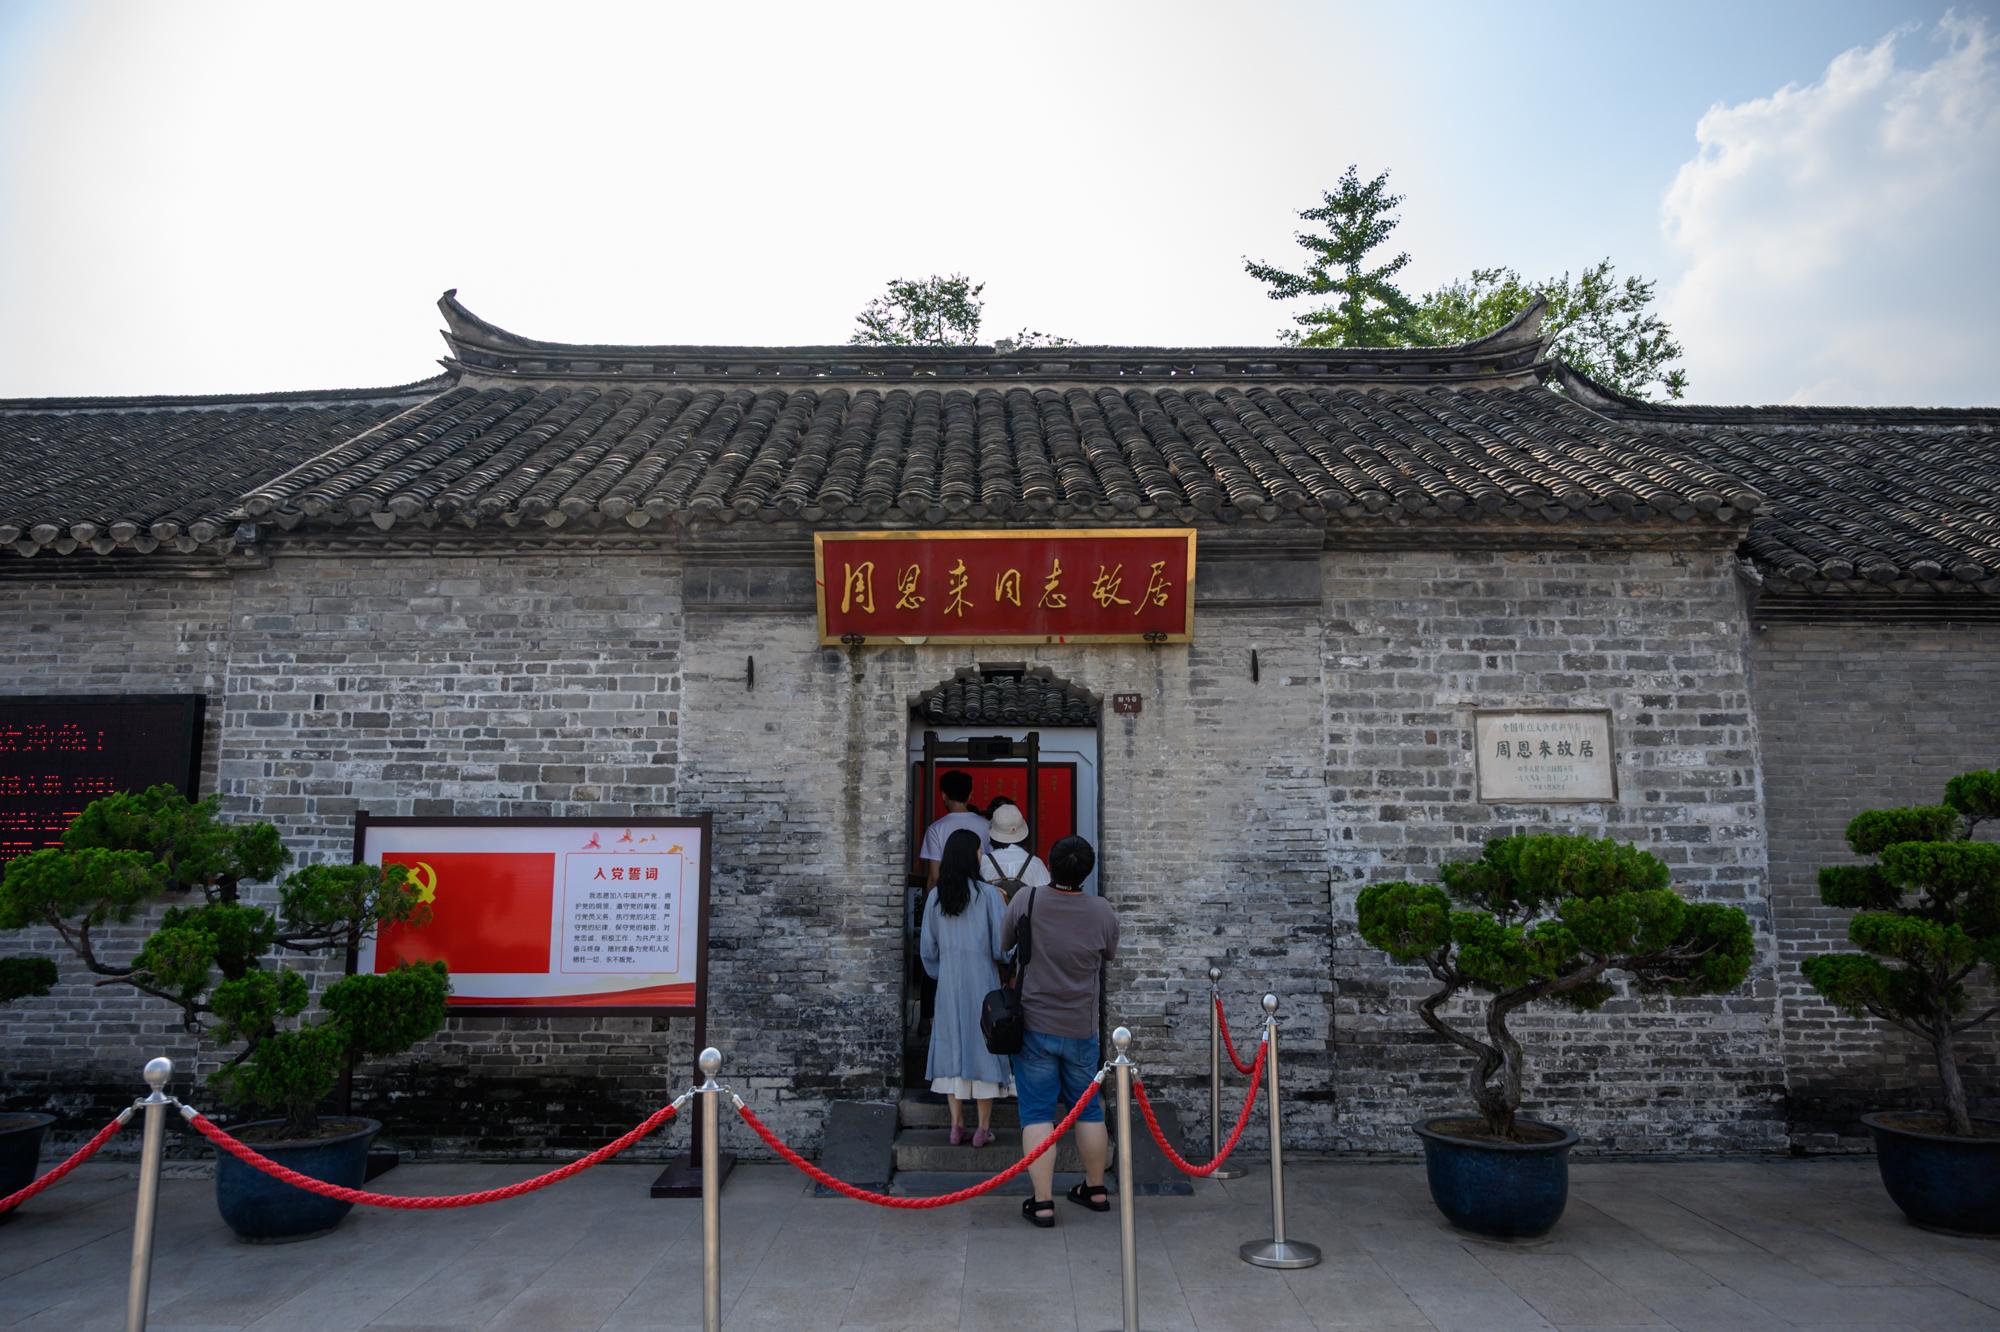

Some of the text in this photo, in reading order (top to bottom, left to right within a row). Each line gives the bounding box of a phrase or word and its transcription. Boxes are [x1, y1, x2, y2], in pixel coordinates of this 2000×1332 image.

[841, 558, 1172, 616] 周恩来同志故居
[1495, 739, 1594, 760] 周恩来故居
[593, 867, 659, 881] 入党誓词
